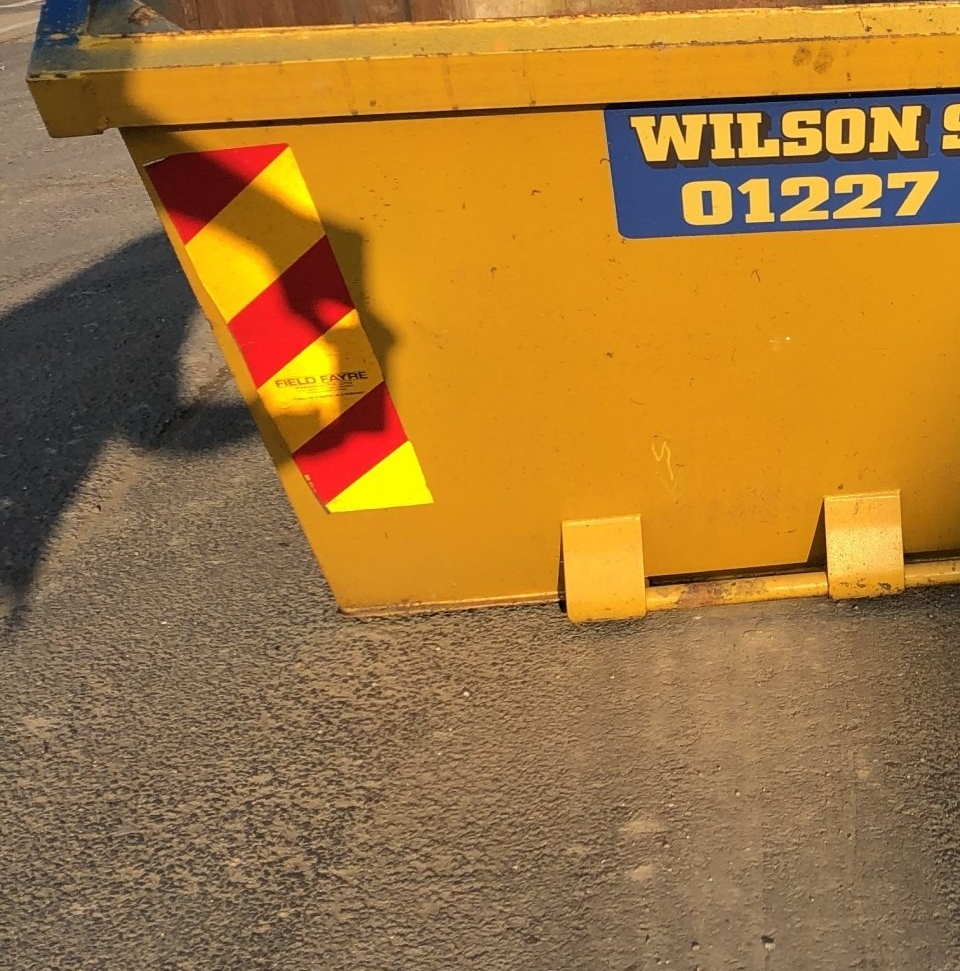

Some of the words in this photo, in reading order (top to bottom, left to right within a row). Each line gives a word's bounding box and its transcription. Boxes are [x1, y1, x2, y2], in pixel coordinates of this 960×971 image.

[630, 103, 930, 169] WILSON
[680, 170, 940, 227] 01227
[274, 375, 317, 389] FIELD
[319, 370, 368, 384] FAYRE
